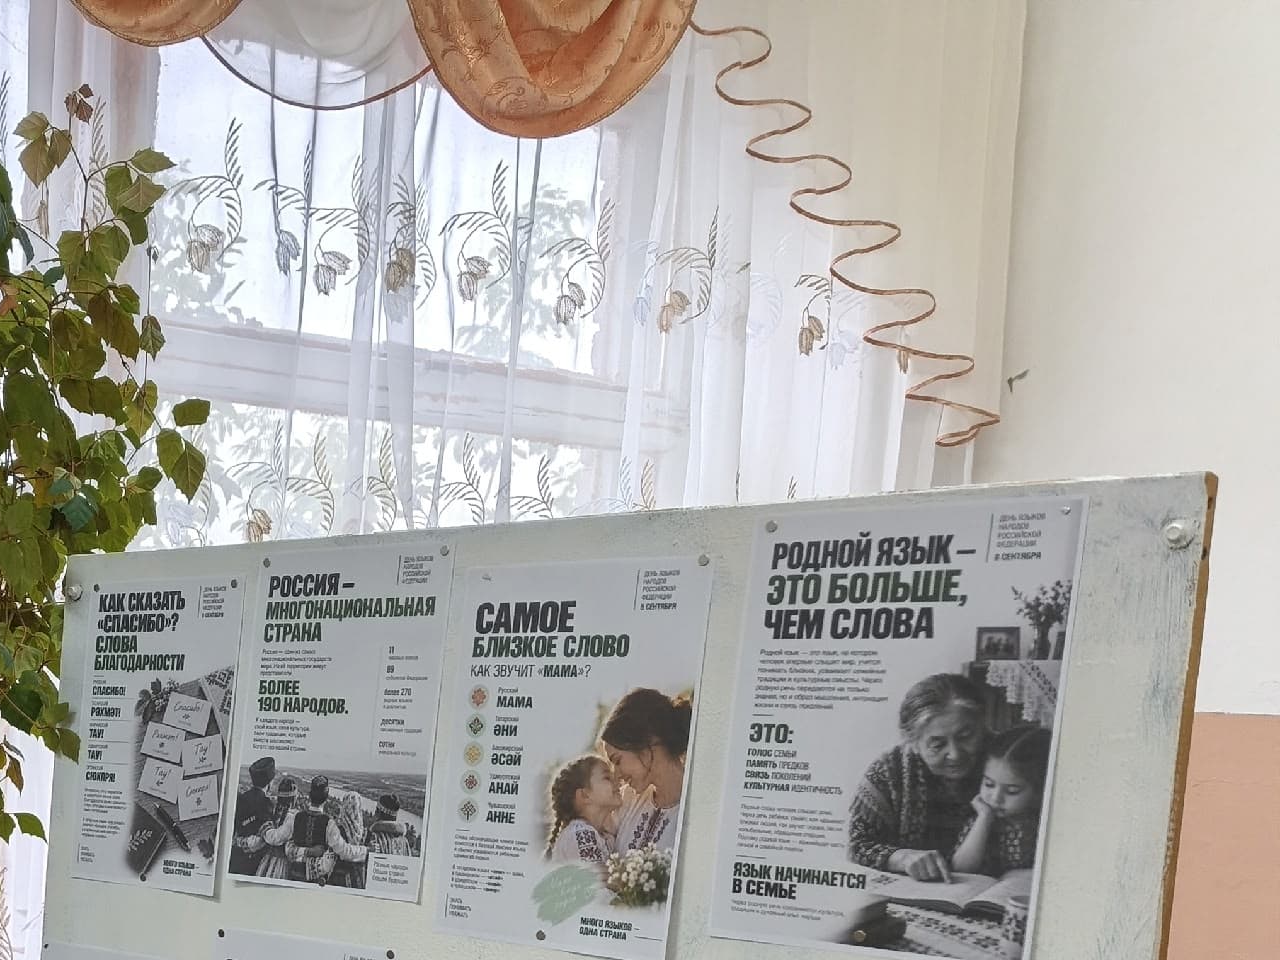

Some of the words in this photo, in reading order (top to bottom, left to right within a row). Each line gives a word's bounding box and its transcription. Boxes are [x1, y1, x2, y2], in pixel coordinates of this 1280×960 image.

[771, 531, 872, 572] РОДНОЙ
[875, 534, 954, 567] ЯЗЫК
[268, 573, 340, 598] РОССИЯ
[766, 574, 822, 605] ЭТО
[827, 569, 968, 606] БОЛЬШЕ,
[99, 593, 126, 612] КАК
[128, 591, 186, 611] СКАЗАТЬ
[265, 596, 437, 622] МНОГОНАЦИОНАЛЬНАЯ
[98, 613, 180, 632] «СПАСИБО»?
[475, 600, 577, 634] САМОЕ
[763, 608, 825, 639] ЧЕМ
[830, 607, 933, 639] СЛОВА
[263, 622, 322, 643] СТРАНА
[96, 635, 138, 653] СЛОВА
[472, 635, 558, 658] БЛИЗКОЕ
[563, 634, 630, 657] СЛОВО
[94, 654, 186, 672] БЛАГОДАРНОСТИ
[470, 665, 490, 677] КАК
[493, 664, 535, 678] ЗВУЧИТ
[537, 664, 592, 678] «МАМА»?
[92, 686, 125, 696] СПАСИБО!
[259, 679, 300, 695] БОЛЕЕ
[257, 697, 281, 712] 190
[283, 698, 349, 716] НАРОДОВ.
[496, 695, 533, 709] МАМА
[494, 724, 518, 737] ӘНИ
[749, 722, 794, 744] ЭТО:
[747, 748, 772, 757] ГОЛОС
[773, 749, 797, 758] СЕМЬИ
[746, 759, 777, 769] ПАМЯТЬ
[778, 761, 809, 770] ПРЕДКОВ
[745, 770, 769, 779] СВЯЗЬ
[488, 781, 519, 795] АНАЙ
[744, 782, 789, 792] КУЛЬТУРНАЯ
[790, 783, 843, 795] ИДЕНТИЧНОСТЬ
[486, 812, 515, 824] АННЕ
[733, 862, 772, 880] ЯЗЫК
[774, 865, 867, 890] НАЧИНАЕТСЯ
[732, 878, 742, 894] В
[745, 881, 797, 900] СЕМЬЕ
